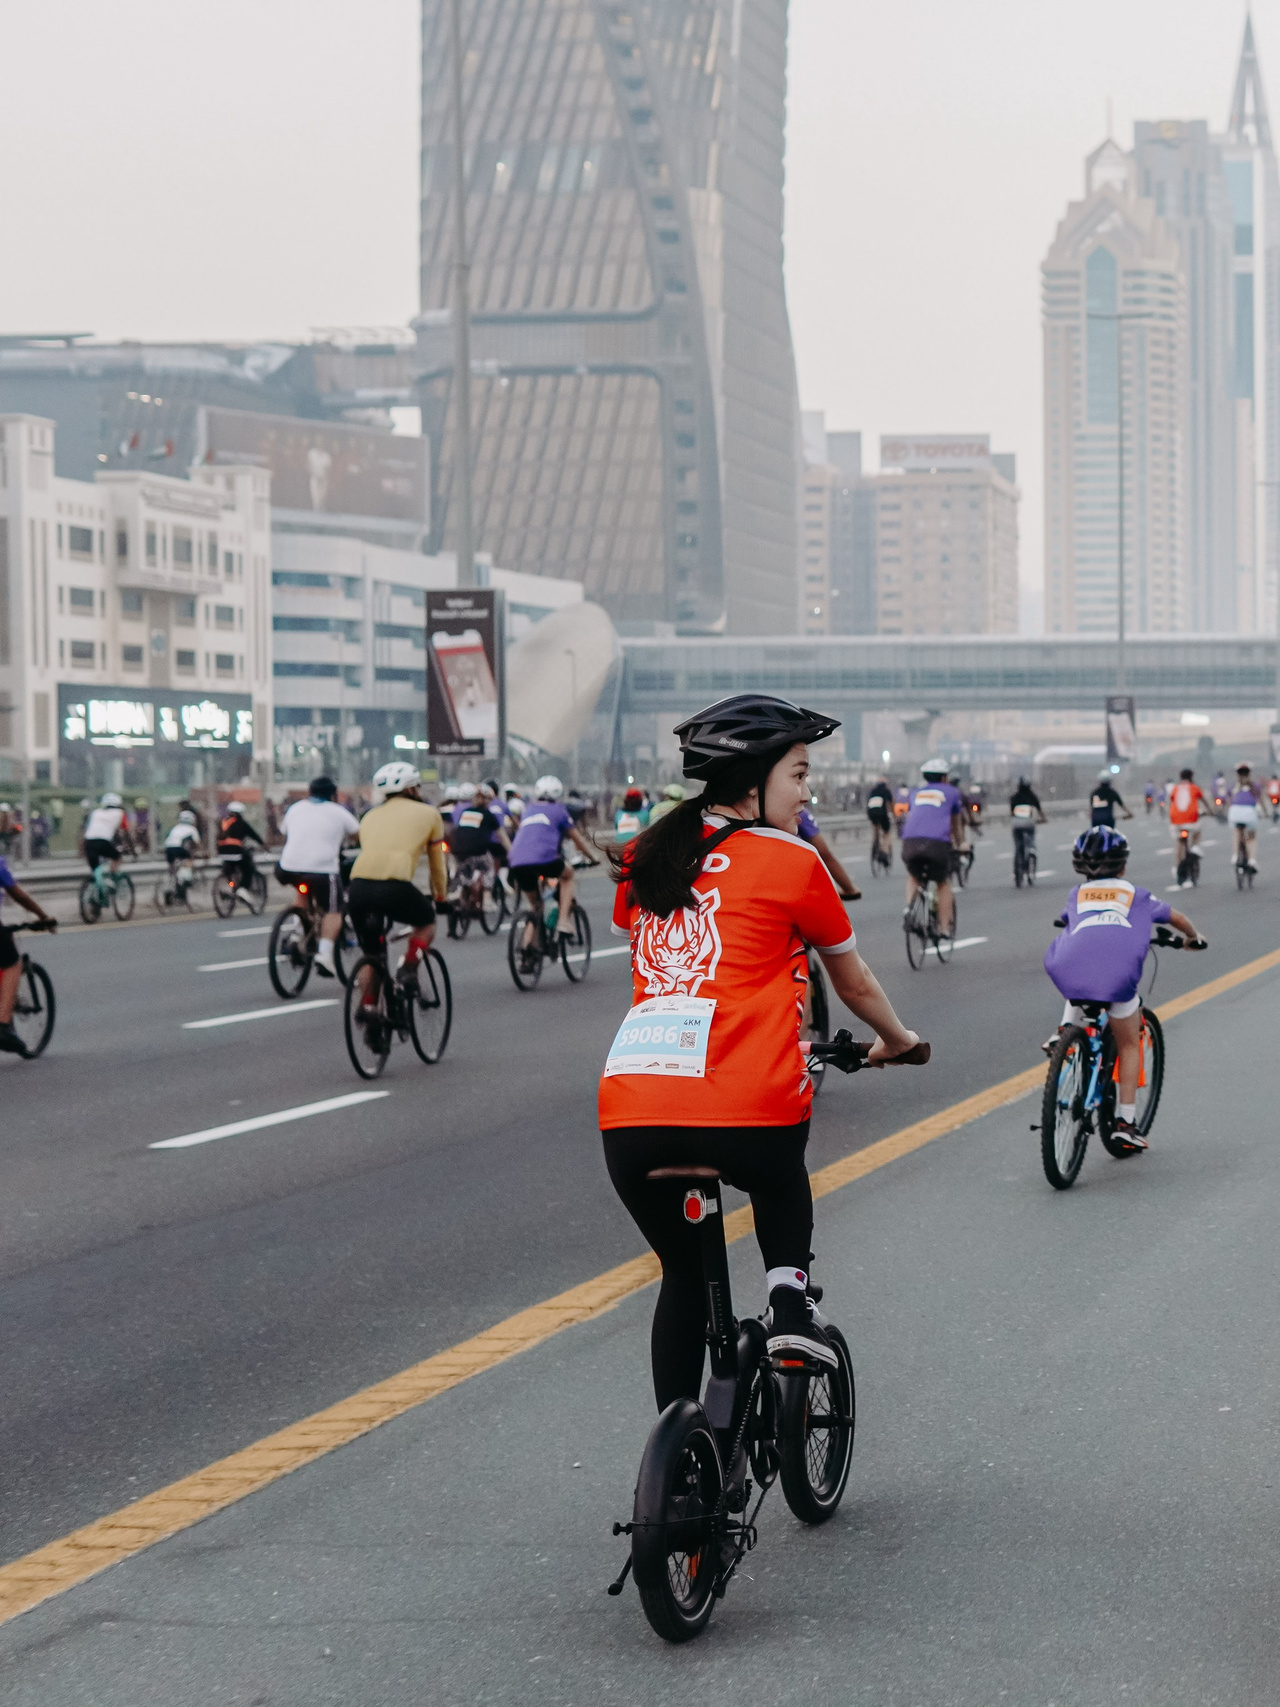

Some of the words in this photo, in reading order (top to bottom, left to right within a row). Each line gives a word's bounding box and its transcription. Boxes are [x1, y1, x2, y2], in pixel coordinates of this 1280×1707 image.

[913, 442, 990, 458] TOYOTA
[1085, 892, 1116, 900] 15415
[1097, 914, 1121, 925] RTA
[618, 1025, 678, 1048] 59086
